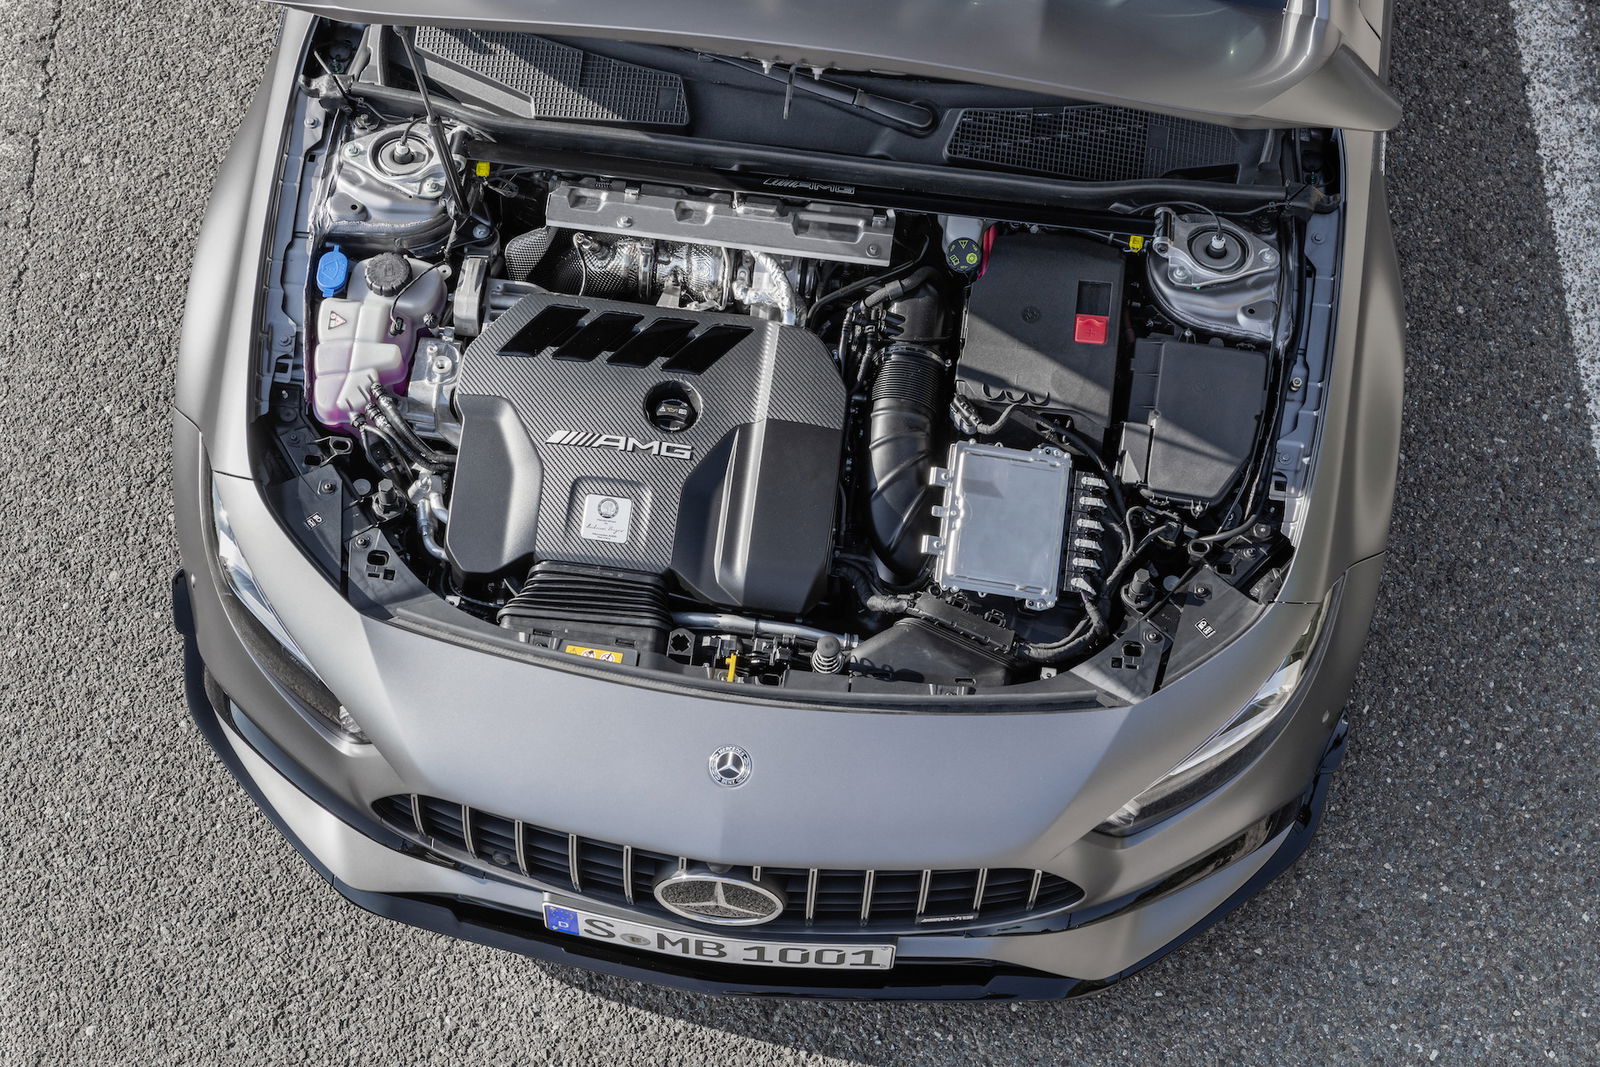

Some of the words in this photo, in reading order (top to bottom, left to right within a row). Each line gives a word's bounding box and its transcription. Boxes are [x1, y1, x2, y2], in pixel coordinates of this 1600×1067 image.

[591, 433, 692, 460] AMG
[558, 920, 570, 928] D
[584, 918, 616, 939] S
[656, 932, 728, 959] MB
[742, 945, 881, 967] 1001
